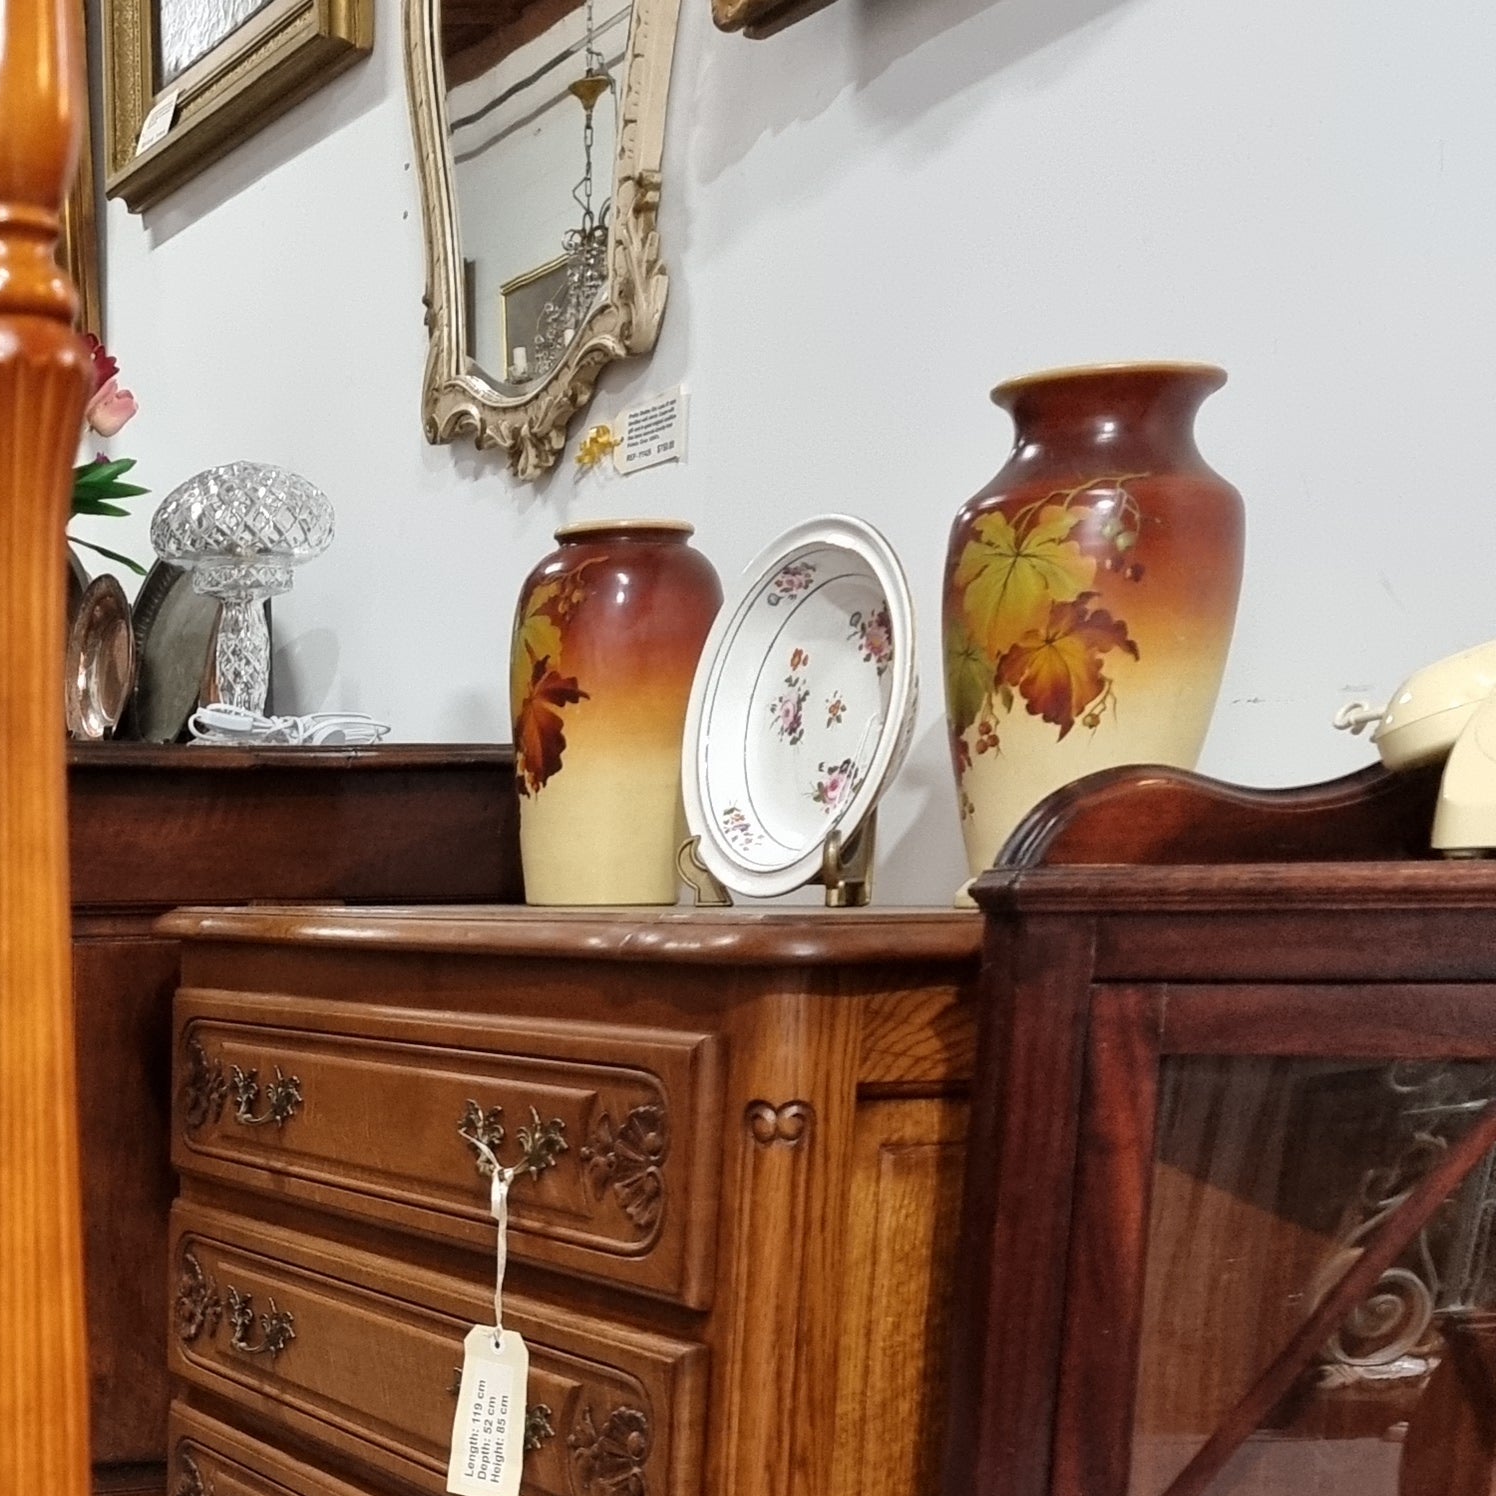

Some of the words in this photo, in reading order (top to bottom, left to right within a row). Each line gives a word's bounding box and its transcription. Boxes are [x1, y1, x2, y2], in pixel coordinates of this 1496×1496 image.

[477, 1380, 486, 1399] cm
[472, 1403, 483, 1423] 119
[487, 1396, 496, 1416] cm
[500, 1395, 509, 1415] cm
[483, 1419, 494, 1434] 52
[496, 1418, 506, 1433] 85
[464, 1428, 480, 1477] Length:
[477, 1438, 491, 1480] Depth:
[490, 1437, 505, 1483] Height:
